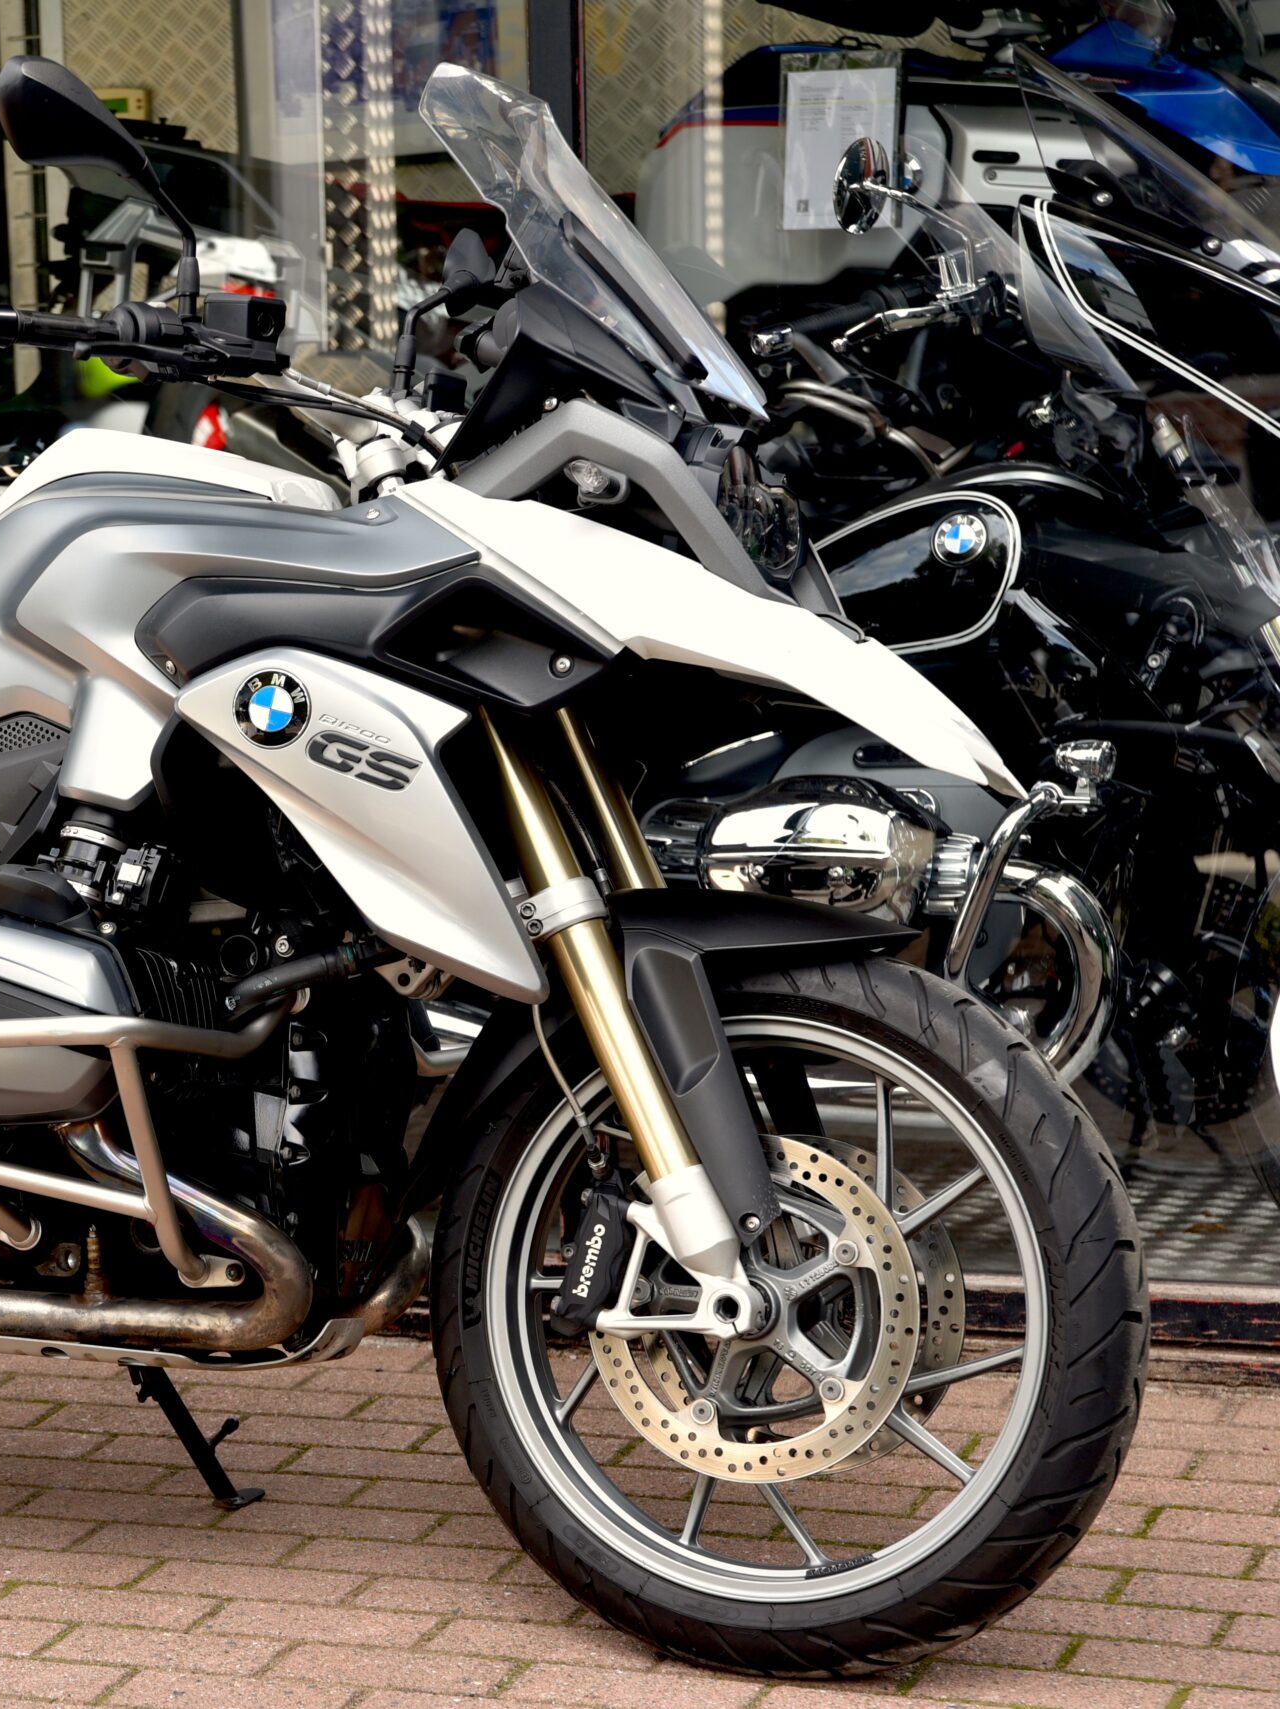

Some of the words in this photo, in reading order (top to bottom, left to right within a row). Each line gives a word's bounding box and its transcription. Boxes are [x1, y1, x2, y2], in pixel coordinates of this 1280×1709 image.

[247, 673, 306, 704] BMW
[308, 733, 420, 791] GS
[465, 1175, 500, 1292] MICHELIN
[572, 1223, 606, 1298] brembo
